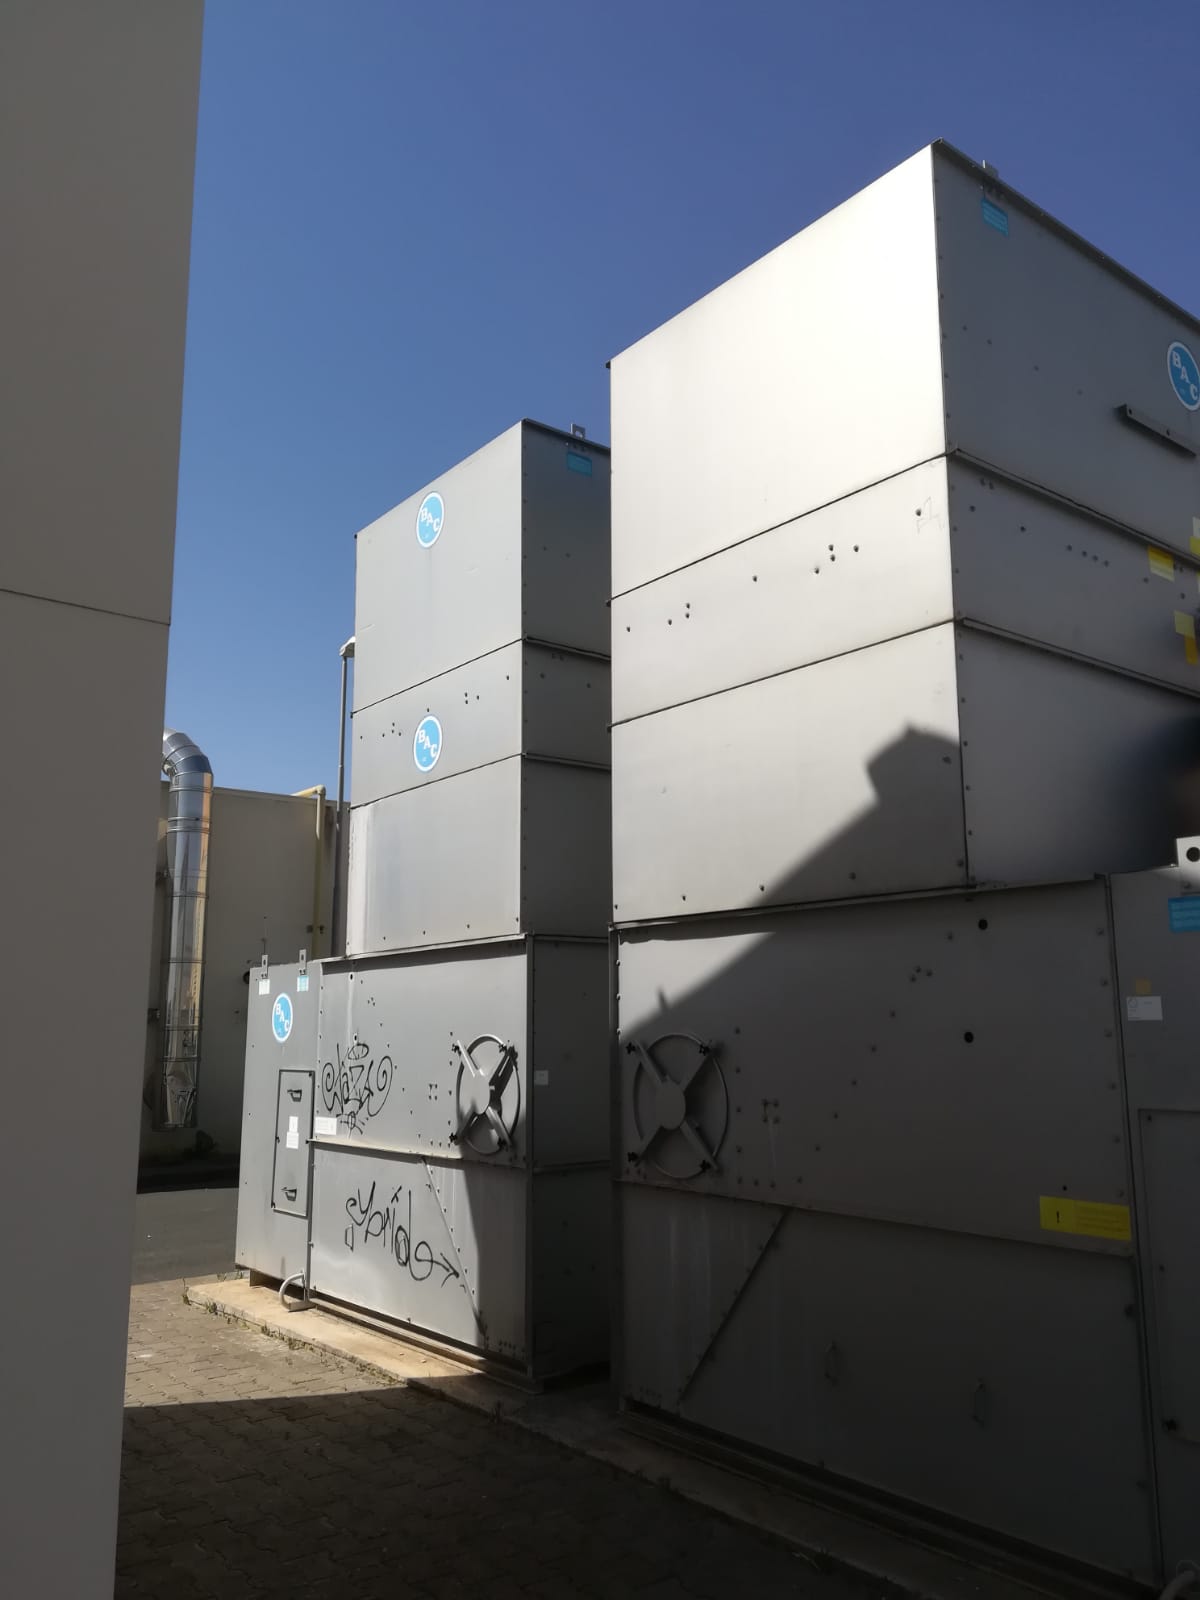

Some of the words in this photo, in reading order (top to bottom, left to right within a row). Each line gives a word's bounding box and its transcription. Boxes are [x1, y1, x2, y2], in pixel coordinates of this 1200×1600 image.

[1172, 350, 1198, 401] BAC
[420, 507, 441, 532] BAC
[418, 729, 438, 758] BAC
[276, 1003, 290, 1032] BAC
